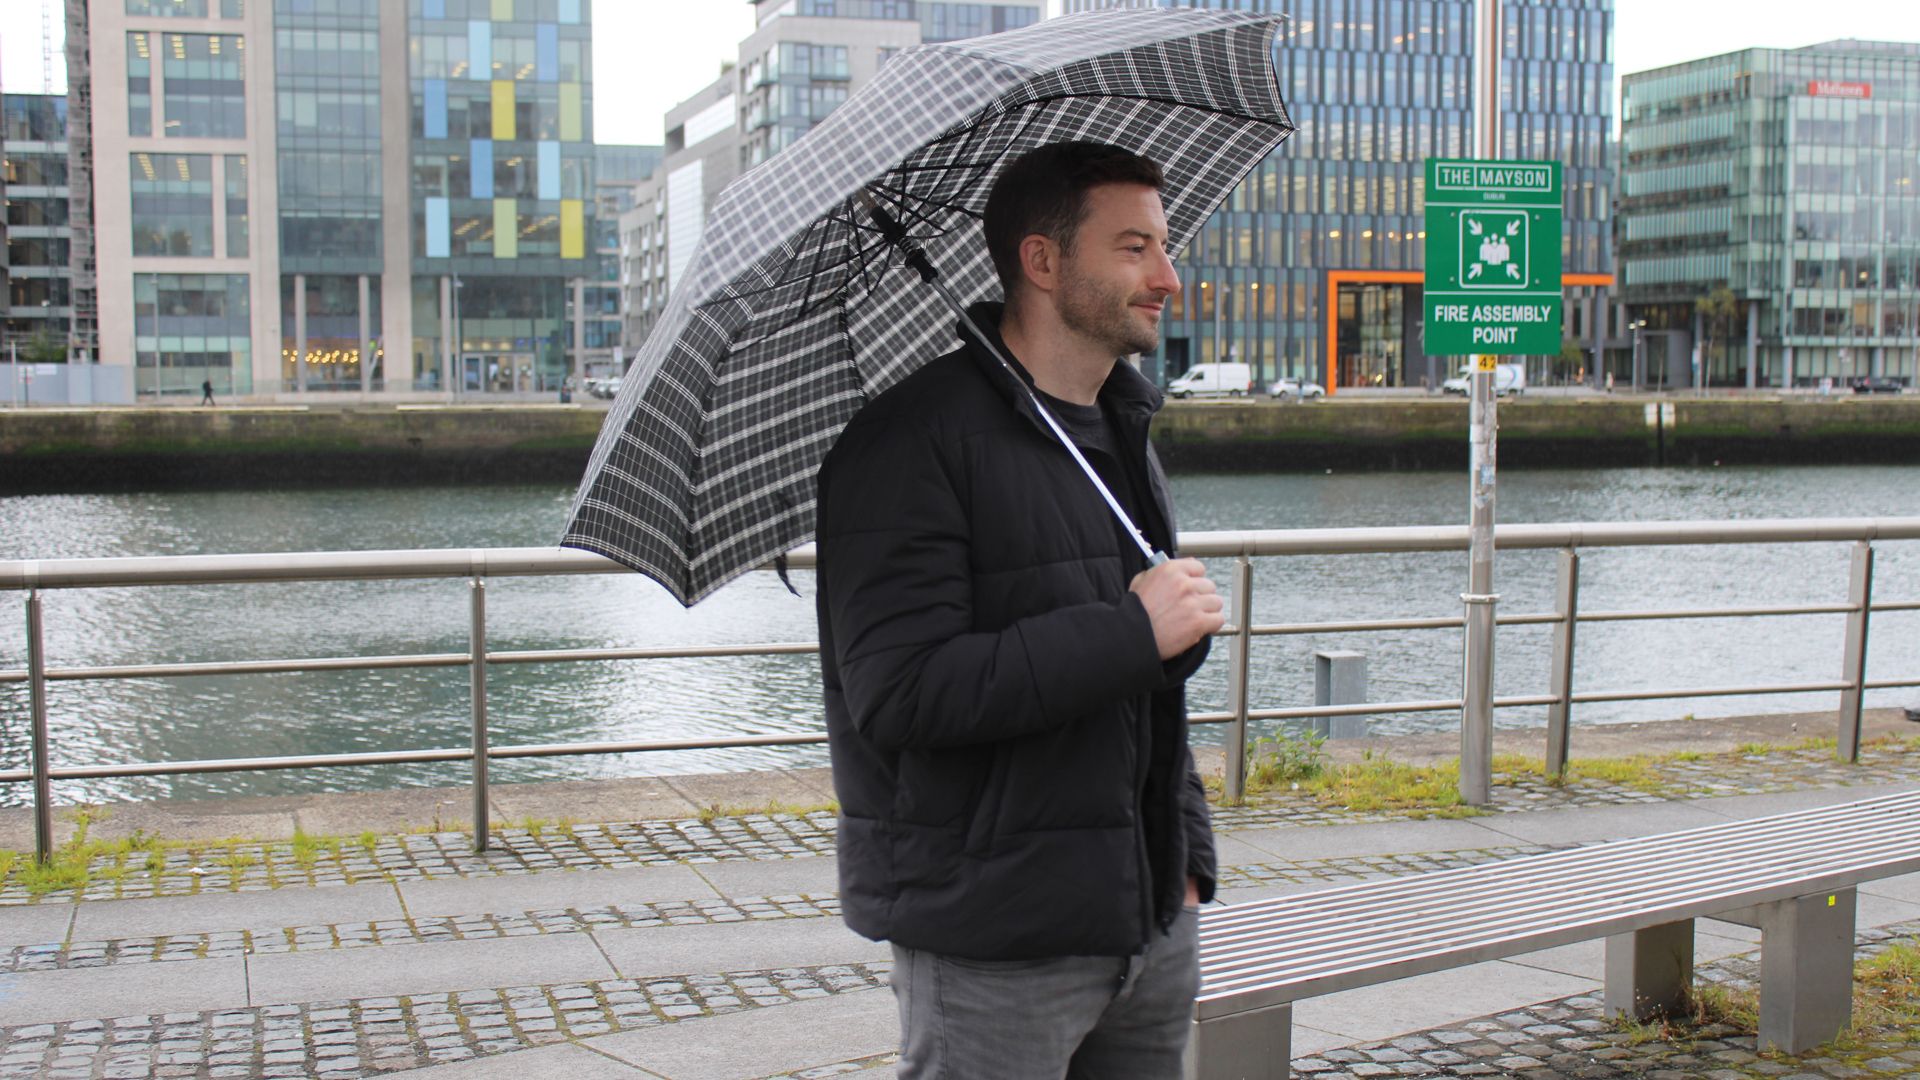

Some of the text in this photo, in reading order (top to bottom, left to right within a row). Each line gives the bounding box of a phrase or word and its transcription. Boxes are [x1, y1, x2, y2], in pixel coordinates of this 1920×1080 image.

[1442, 168, 1546, 187] THE MAYSON
[1434, 305, 1552, 323] FIRE ASSEMBLY
[1472, 327, 1518, 344] POINT
